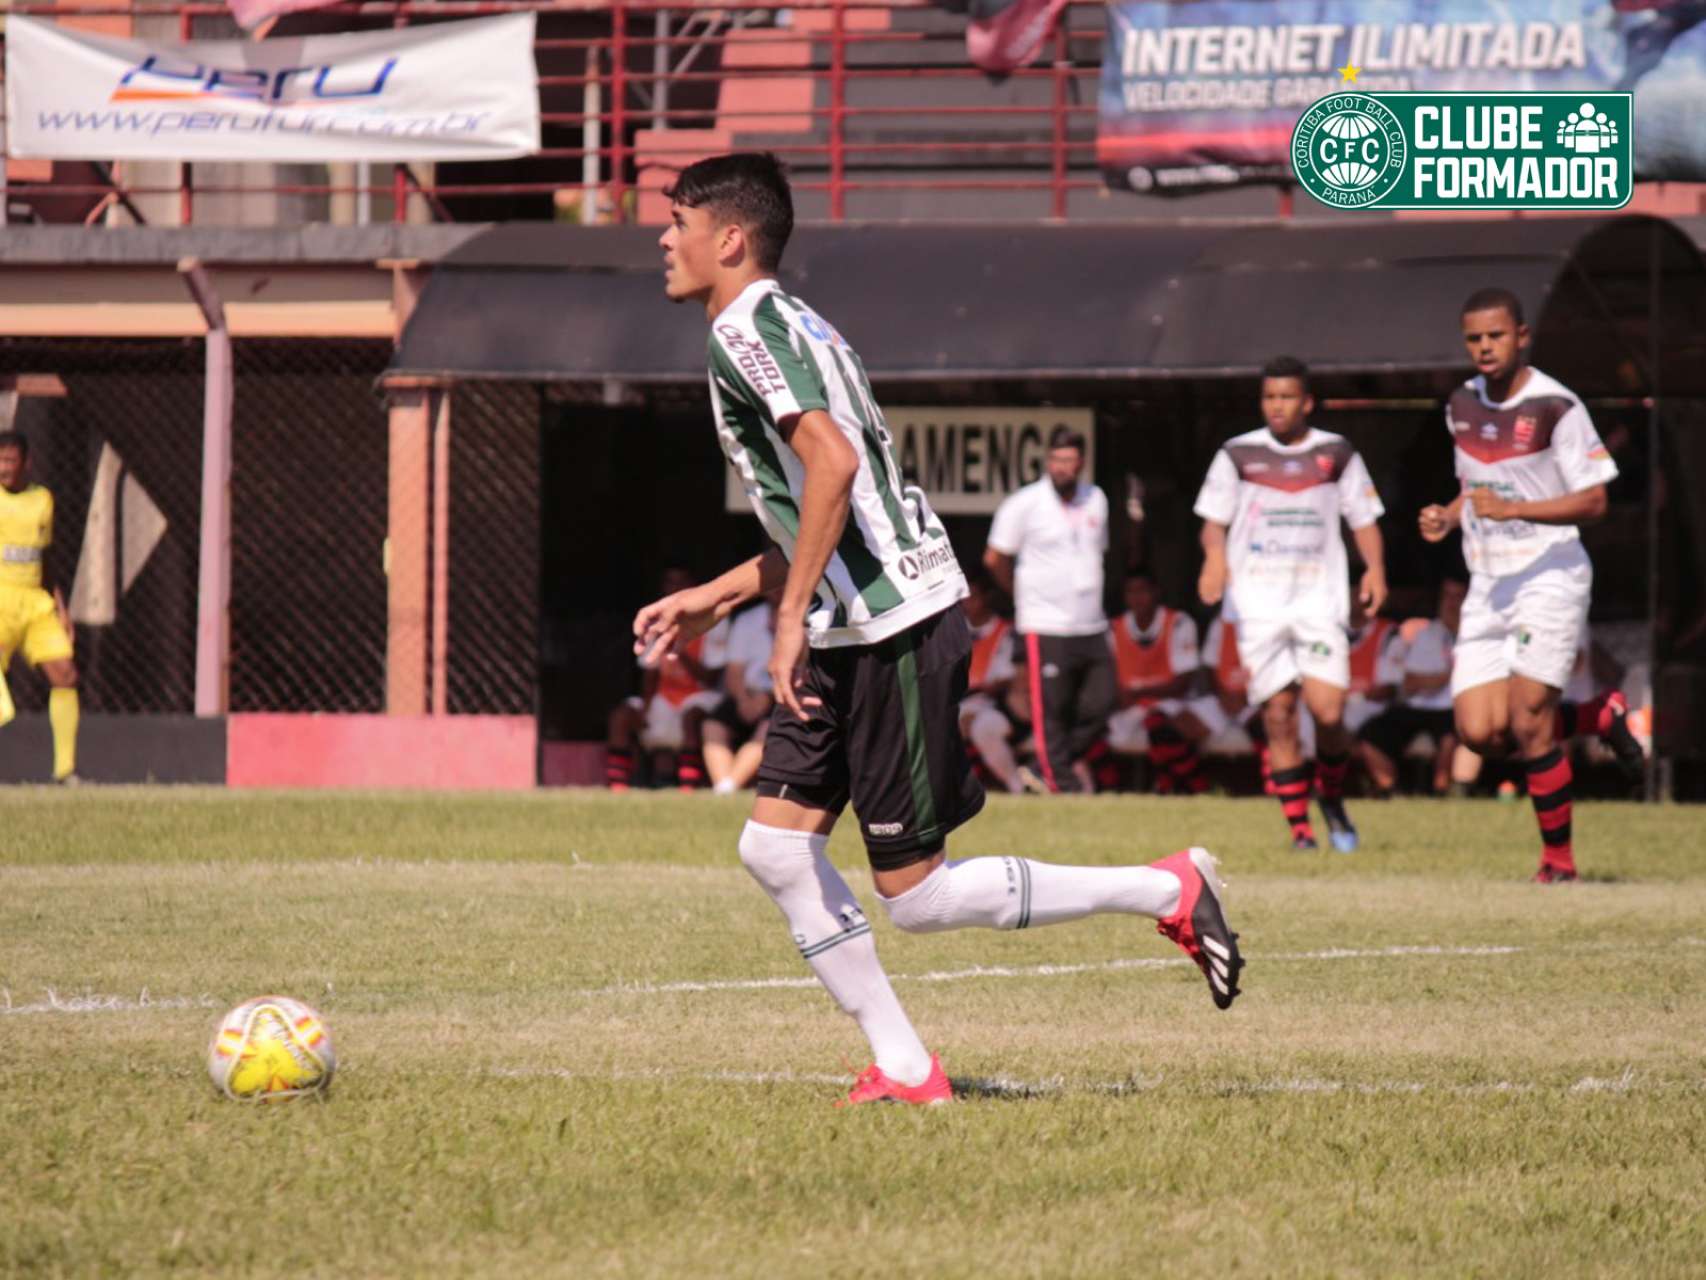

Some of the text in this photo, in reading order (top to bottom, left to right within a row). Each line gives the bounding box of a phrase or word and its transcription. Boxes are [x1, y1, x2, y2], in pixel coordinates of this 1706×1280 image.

[1121, 20, 1586, 76] INTERNET ILIMITADA
[1123, 79, 1272, 112] VELOCIDADE
[901, 423, 1086, 493] AMENG
